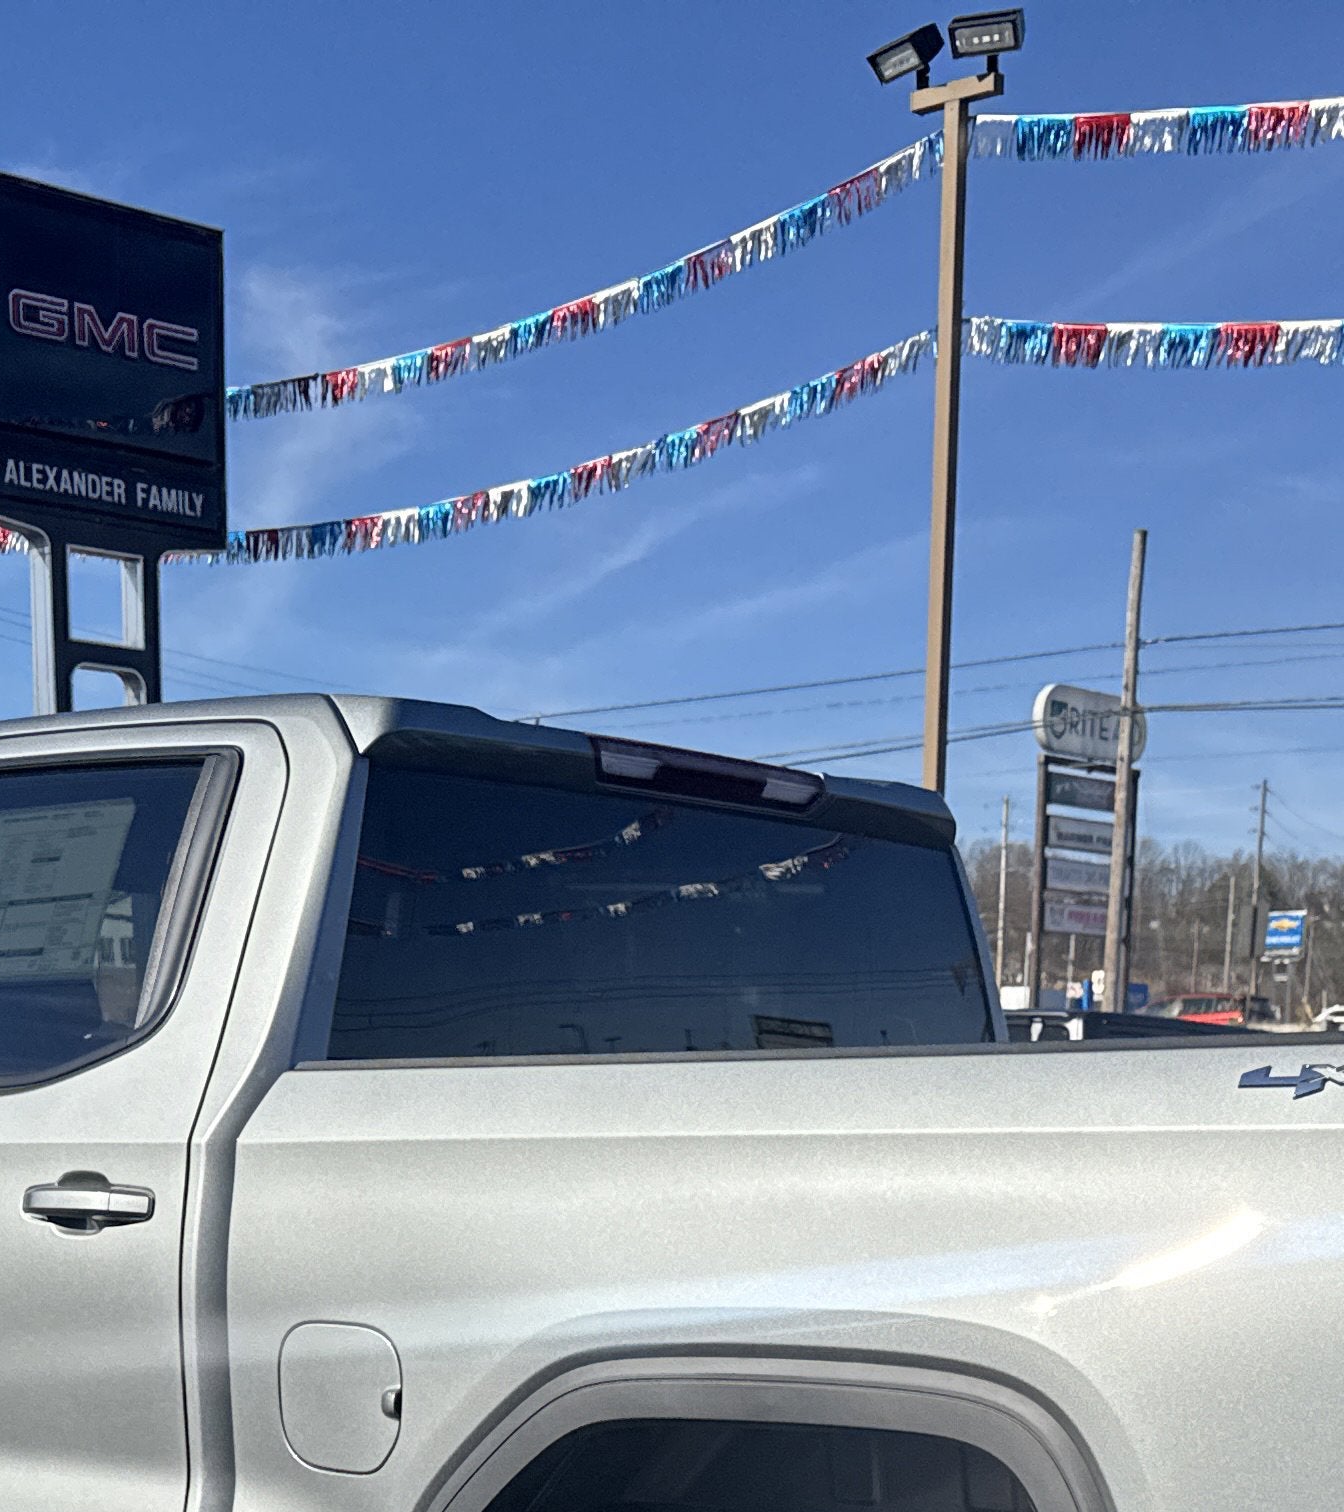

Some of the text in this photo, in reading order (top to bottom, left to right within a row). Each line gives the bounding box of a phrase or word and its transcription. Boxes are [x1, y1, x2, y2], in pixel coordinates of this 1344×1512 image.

[8, 288, 199, 371] GMC
[5, 459, 203, 518] ALEXANDER FAMILY
[1069, 706, 1109, 741] RITE
